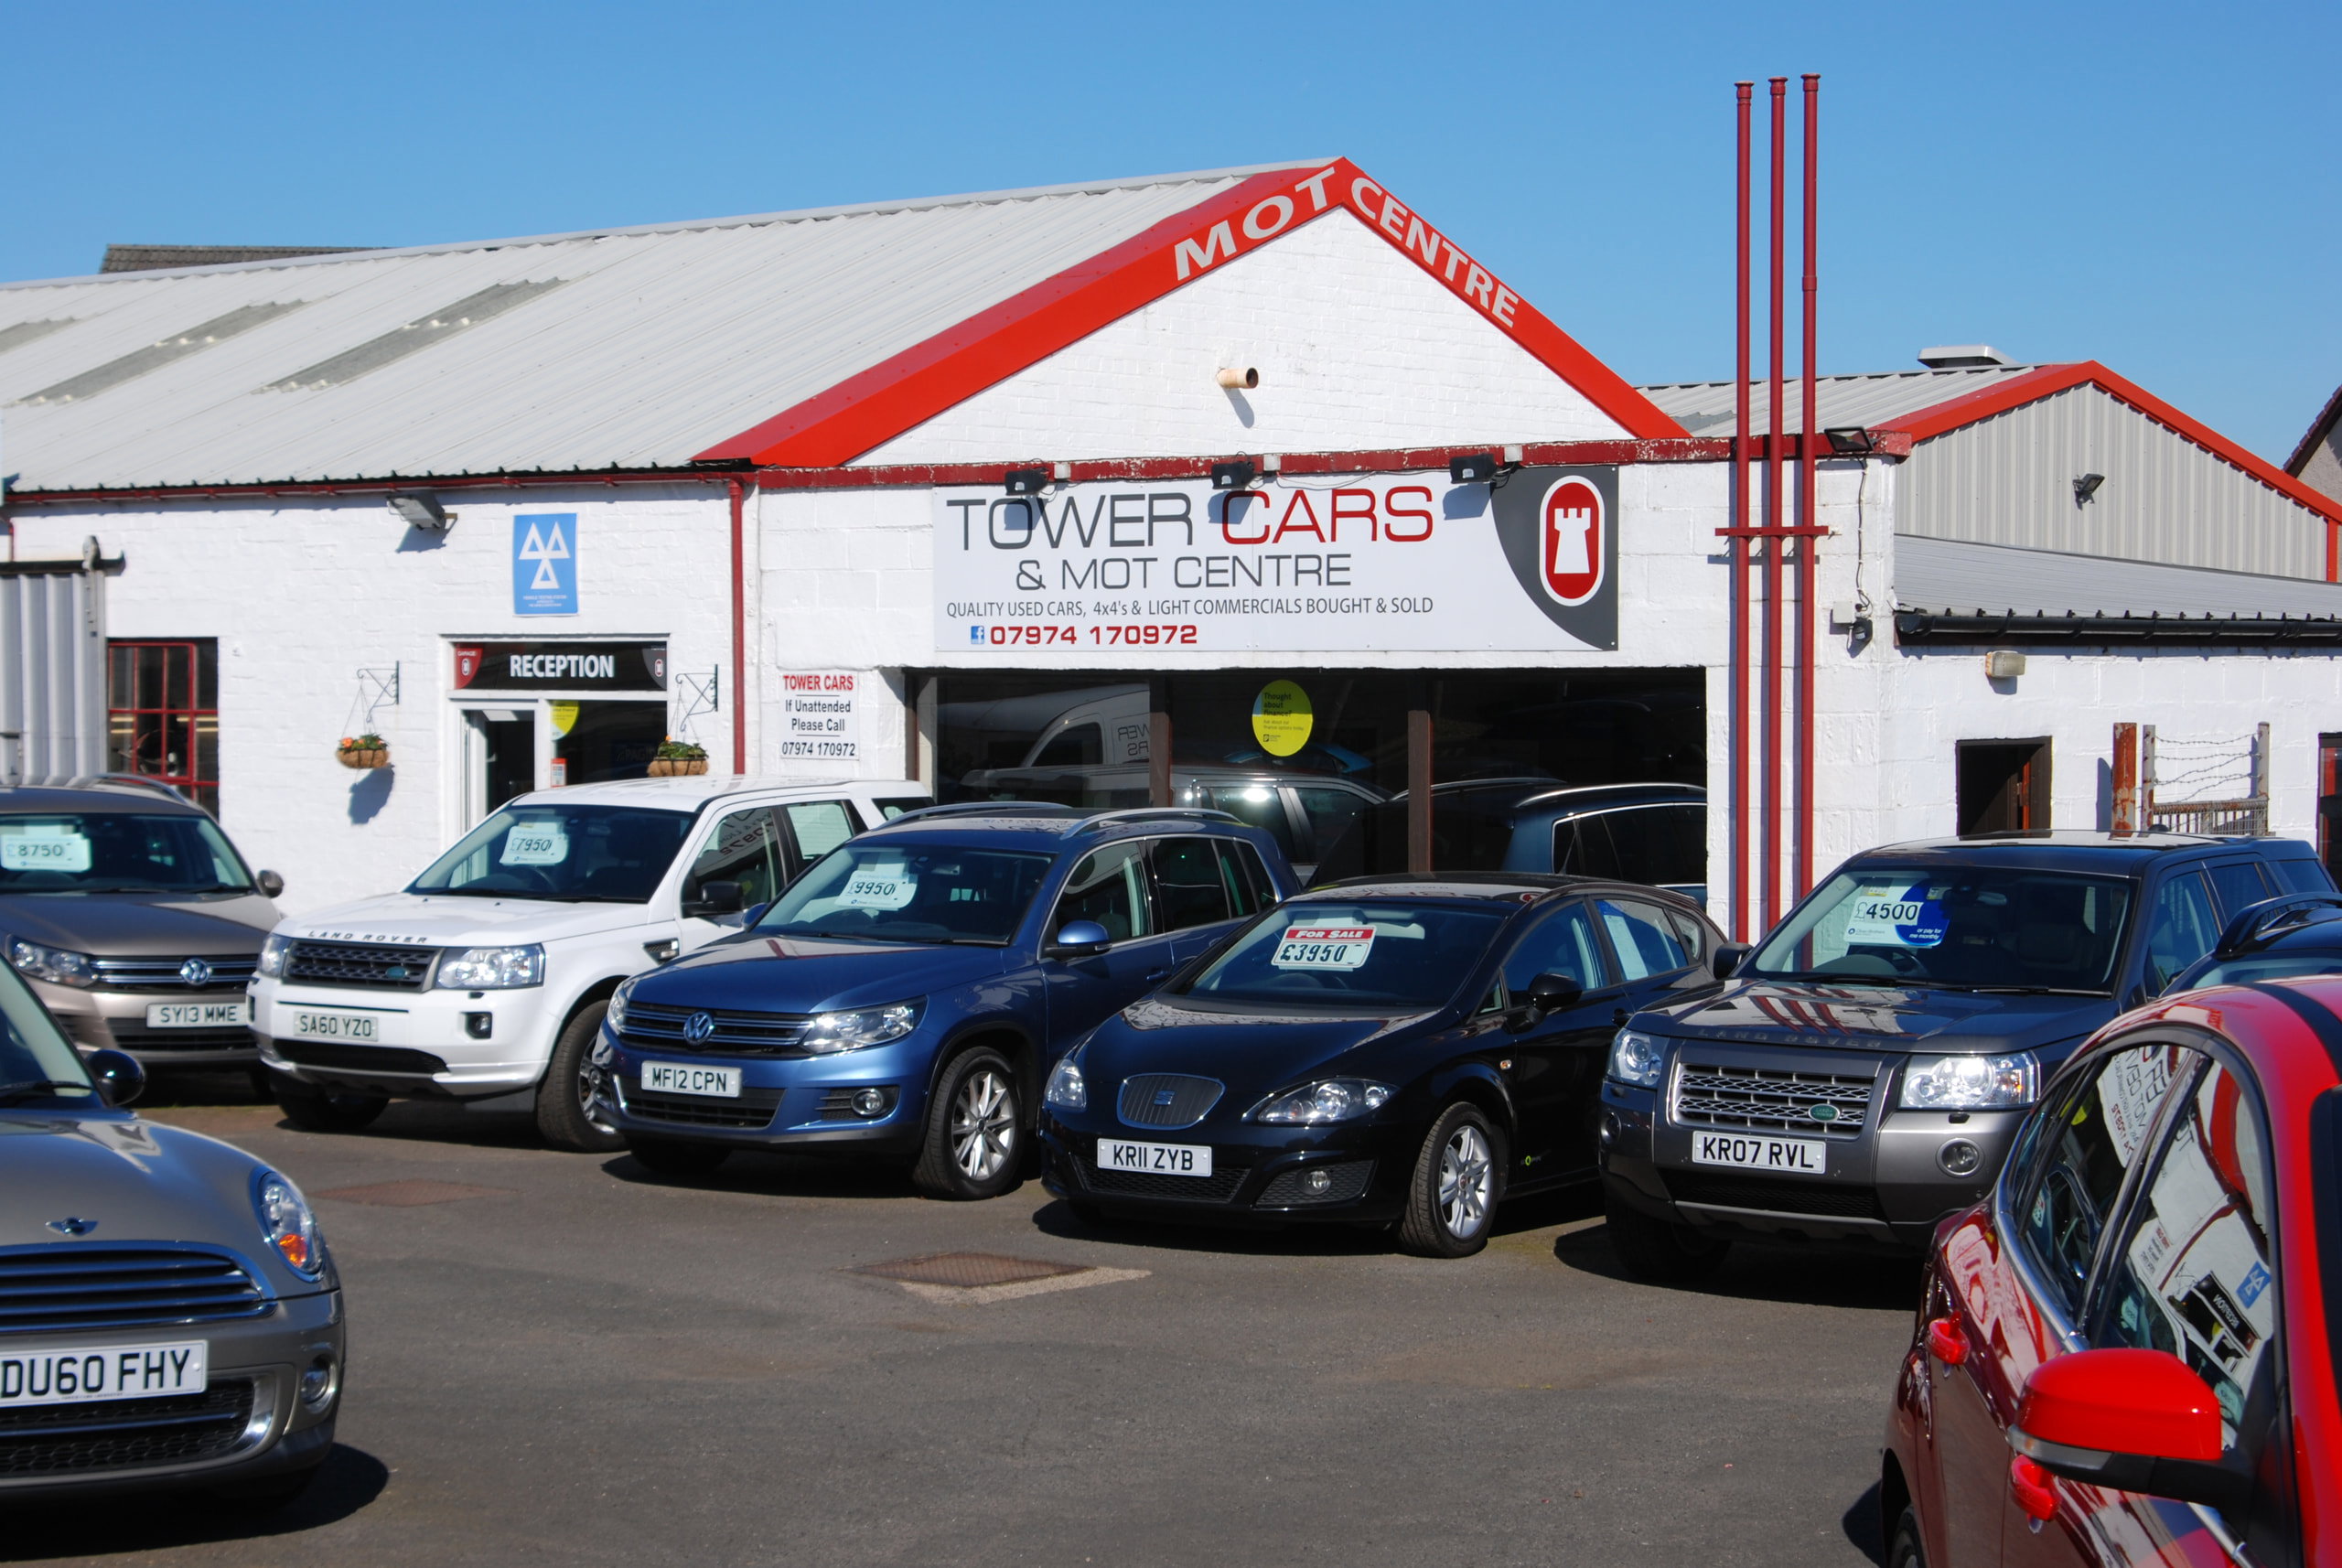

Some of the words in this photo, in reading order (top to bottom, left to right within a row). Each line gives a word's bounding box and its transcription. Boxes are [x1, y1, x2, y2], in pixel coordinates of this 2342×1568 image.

[1175, 166, 1336, 281] MOT
[1350, 177, 1519, 328] CENTRE
[946, 492, 1193, 551] TOWER
[1221, 486, 1434, 544] CARS
[1016, 559, 1046, 590] &
[1062, 557, 1158, 589] MOT
[1174, 553, 1351, 588] CENTRE
[946, 602, 1004, 618] QUALITY
[1007, 601, 1044, 617] USED
[1047, 601, 1087, 618] CARS,
[1093, 600, 1128, 616] 4x4's
[1131, 600, 1142, 615] &
[1148, 599, 1191, 616] LIGHT
[1193, 598, 1302, 615] COMMERCIALS
[1306, 597, 1372, 614] BOUGHT
[1375, 596, 1387, 614] &
[1391, 596, 1434, 614] SOLD
[990, 626, 1078, 645] 07974
[1089, 625, 1198, 644] 170972
[510, 654, 615, 678] RECEPTION
[783, 674, 822, 691] TOWER
[823, 674, 854, 691] CARS
[785, 699, 792, 712] If
[795, 699, 852, 713] Unattended
[791, 717, 823, 731] Please
[826, 718, 845, 732] Call
[781, 741, 813, 756] 07974
[817, 742, 856, 757] 170972
[307, 930, 354, 940] LAND
[362, 934, 429, 944] ROVER
[1295, 930, 1324, 939] FOR
[1327, 930, 1364, 939] SALE
[1280, 943, 1348, 962] £3950
[159, 1006, 199, 1024] SY13
[205, 1005, 238, 1023] MME
[299, 1015, 338, 1036] SA60
[1697, 1029, 1768, 1041] LAND
[1785, 1034, 1881, 1047] ROVER
[652, 1067, 688, 1090] MF12
[693, 1070, 726, 1092] CPN
[1113, 1144, 1148, 1168] KR11
[1154, 1147, 1193, 1171] ZYB
[1703, 1136, 1762, 1164] KR07
[1768, 1142, 1814, 1168] RVL
[0, 1355, 105, 1399] DU60
[117, 1348, 190, 1391] FHY
